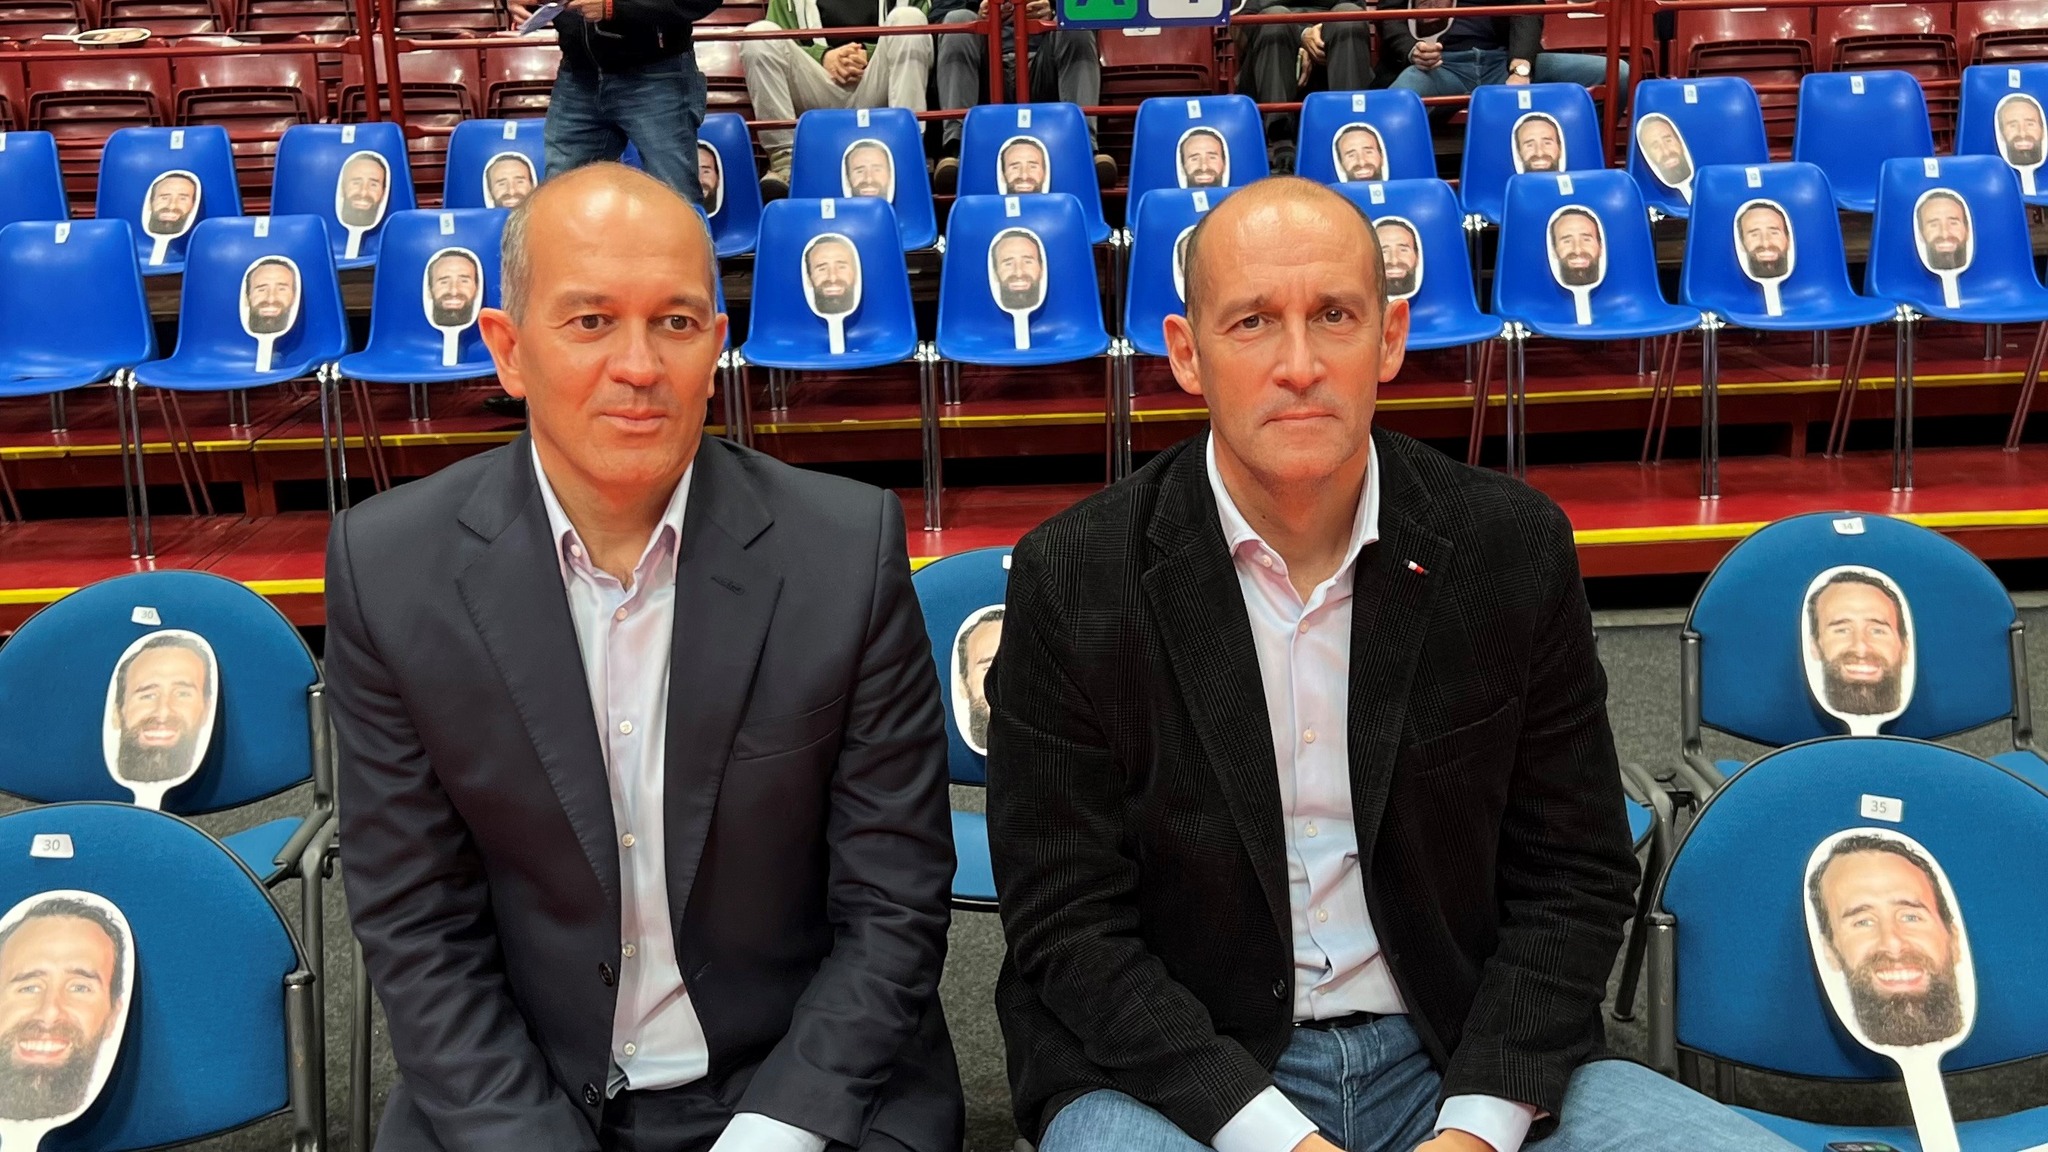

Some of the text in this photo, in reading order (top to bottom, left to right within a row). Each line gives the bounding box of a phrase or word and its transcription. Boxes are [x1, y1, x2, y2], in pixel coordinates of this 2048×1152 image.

[1198, 196, 1203, 204] 9
[825, 204, 831, 212] 7
[1010, 202, 1016, 210] 8
[141, 610, 154, 619] 30
[1871, 800, 1887, 814] 35
[43, 839, 60, 851] 30
